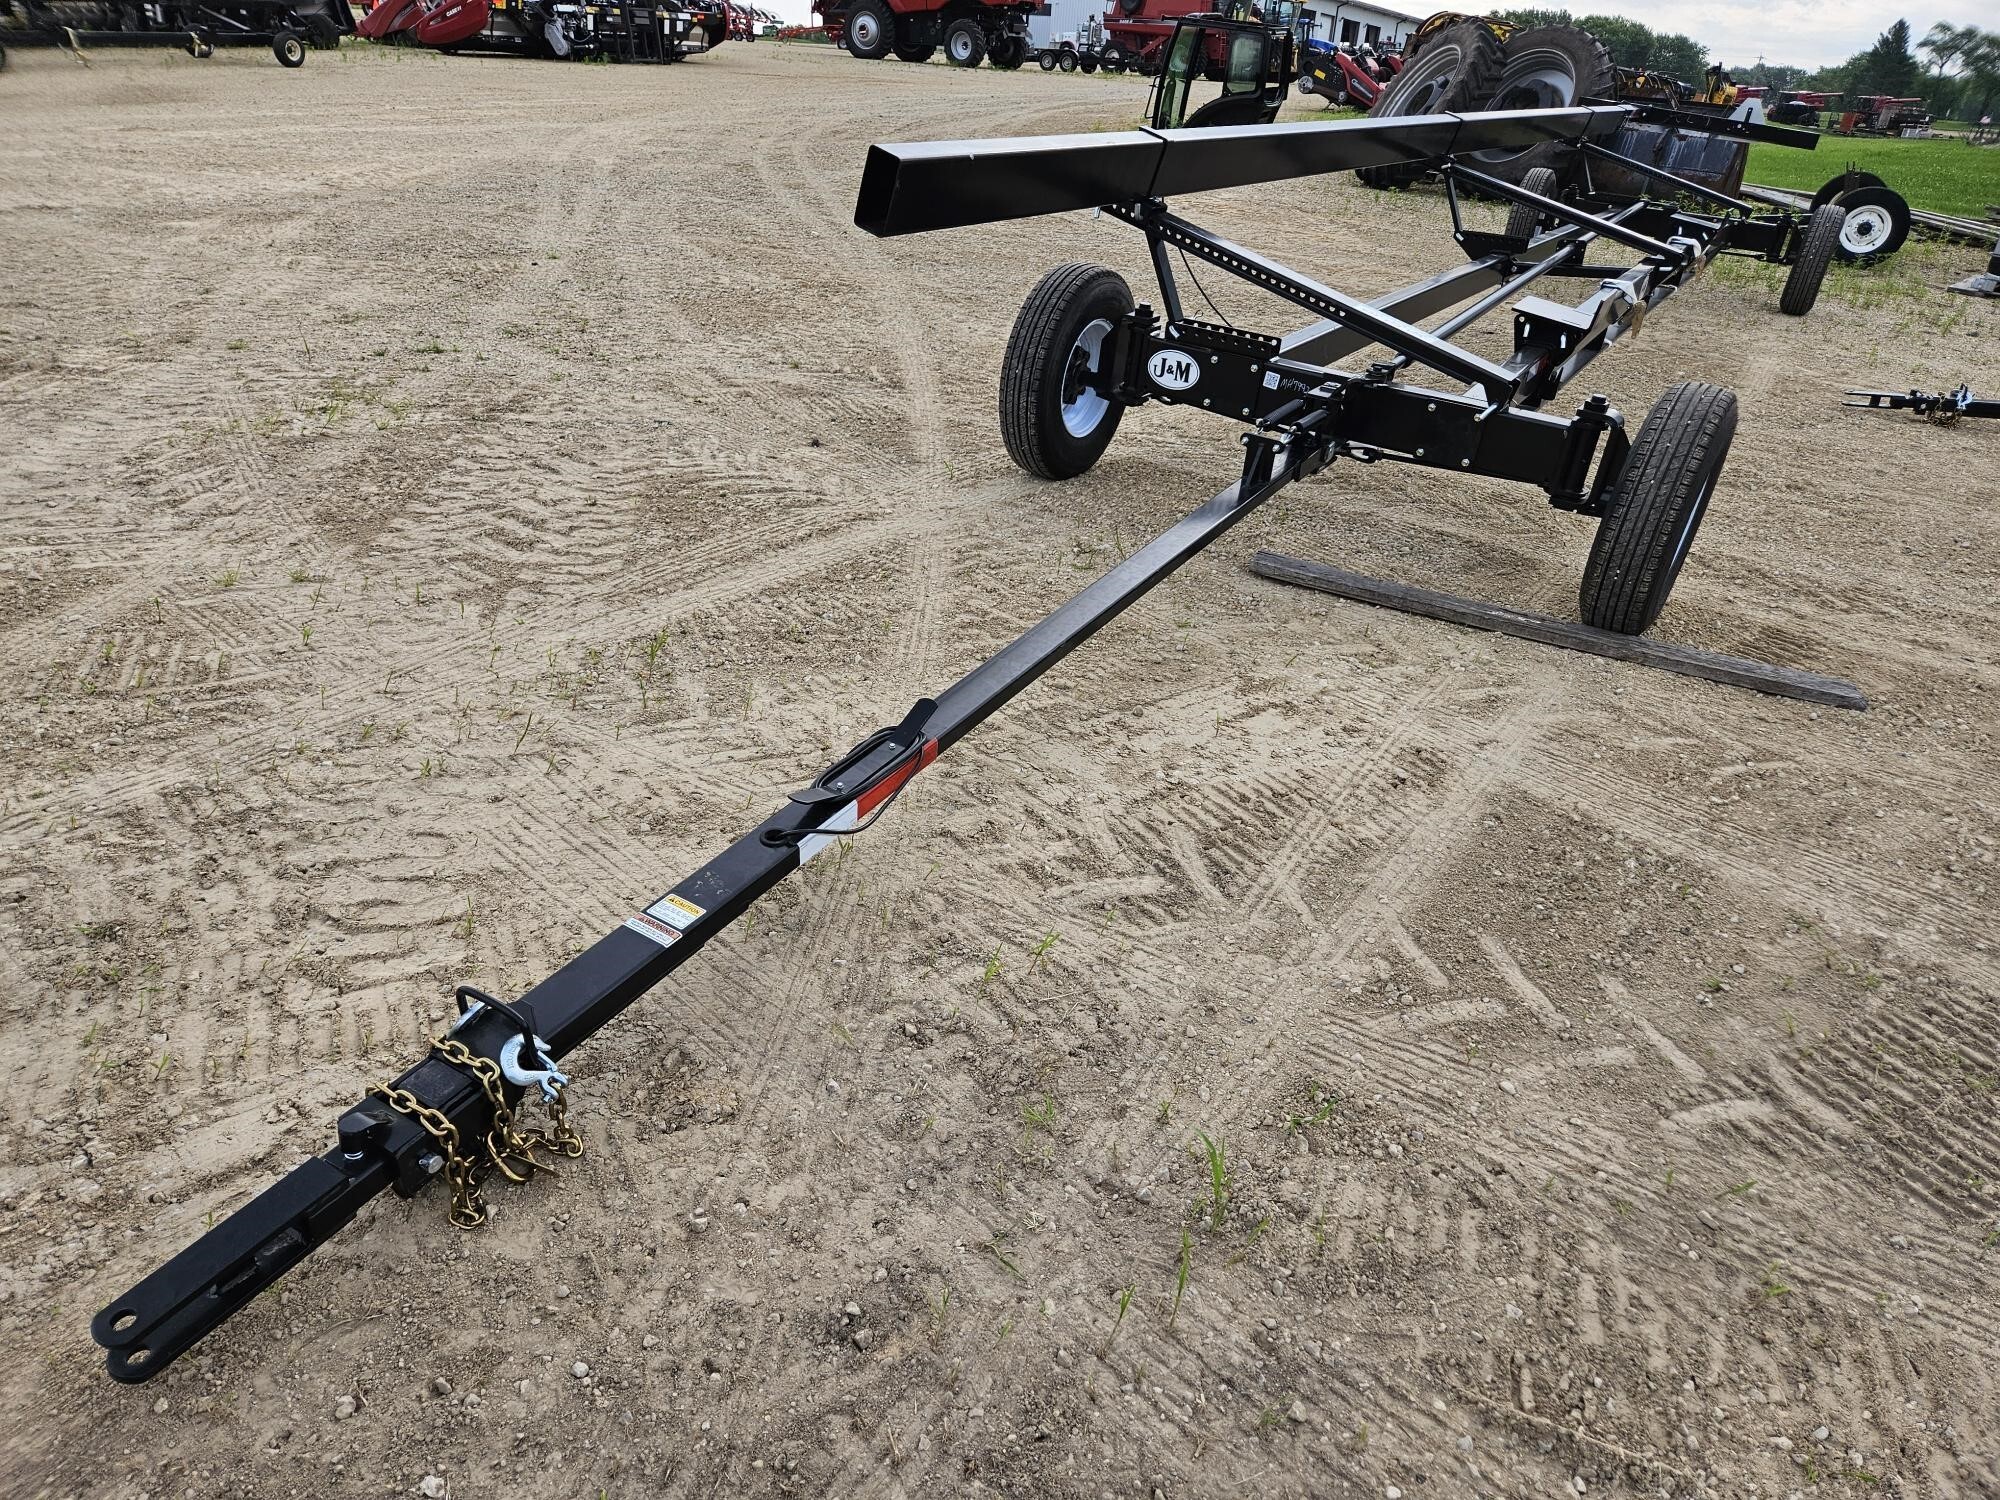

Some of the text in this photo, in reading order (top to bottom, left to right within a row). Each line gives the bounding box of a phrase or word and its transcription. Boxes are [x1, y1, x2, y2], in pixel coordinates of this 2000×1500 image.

[1153, 357, 1192, 383] J&M
[675, 900, 700, 915] CAUTION
[645, 917, 675, 936] WARNING
